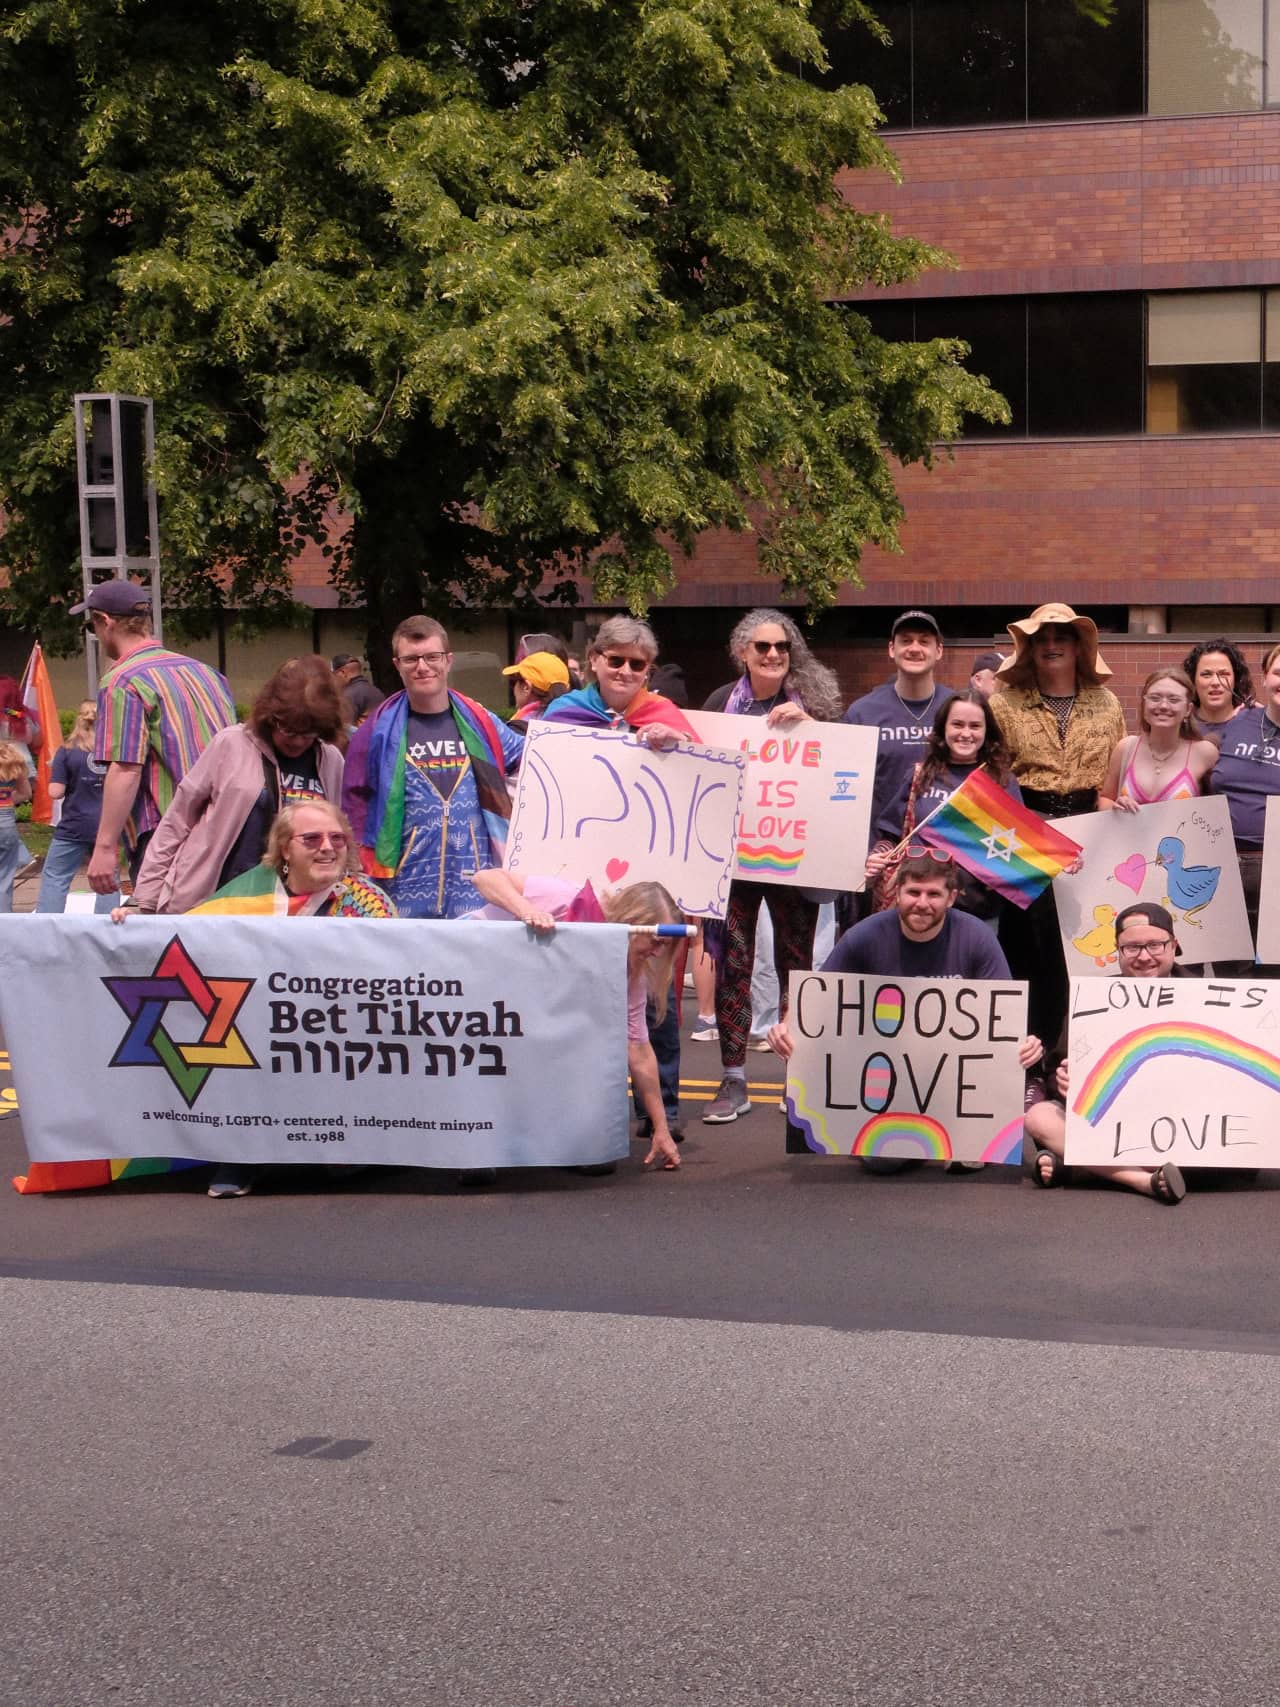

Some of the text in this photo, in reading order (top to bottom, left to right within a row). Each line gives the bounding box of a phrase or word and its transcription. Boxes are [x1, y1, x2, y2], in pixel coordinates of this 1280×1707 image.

[740, 739, 822, 769] LOVE
[527, 749, 726, 863] אהבה
[757, 780, 798, 809] IS
[739, 815, 808, 841] LOVE
[268, 972, 464, 1001] Congregation
[1072, 981, 1268, 1019] LOVE IS
[269, 999, 524, 1037] Bet Tikvah
[797, 977, 1022, 1042] CHOOSE
[270, 1040, 507, 1081] בית תקווה
[825, 1052, 995, 1119] LOVE
[142, 1109, 493, 1133] a welcoming, LGBTQ+ centered, independent minyan
[287, 1131, 345, 1144] est. 1988
[1113, 1114, 1258, 1158] LOVE
